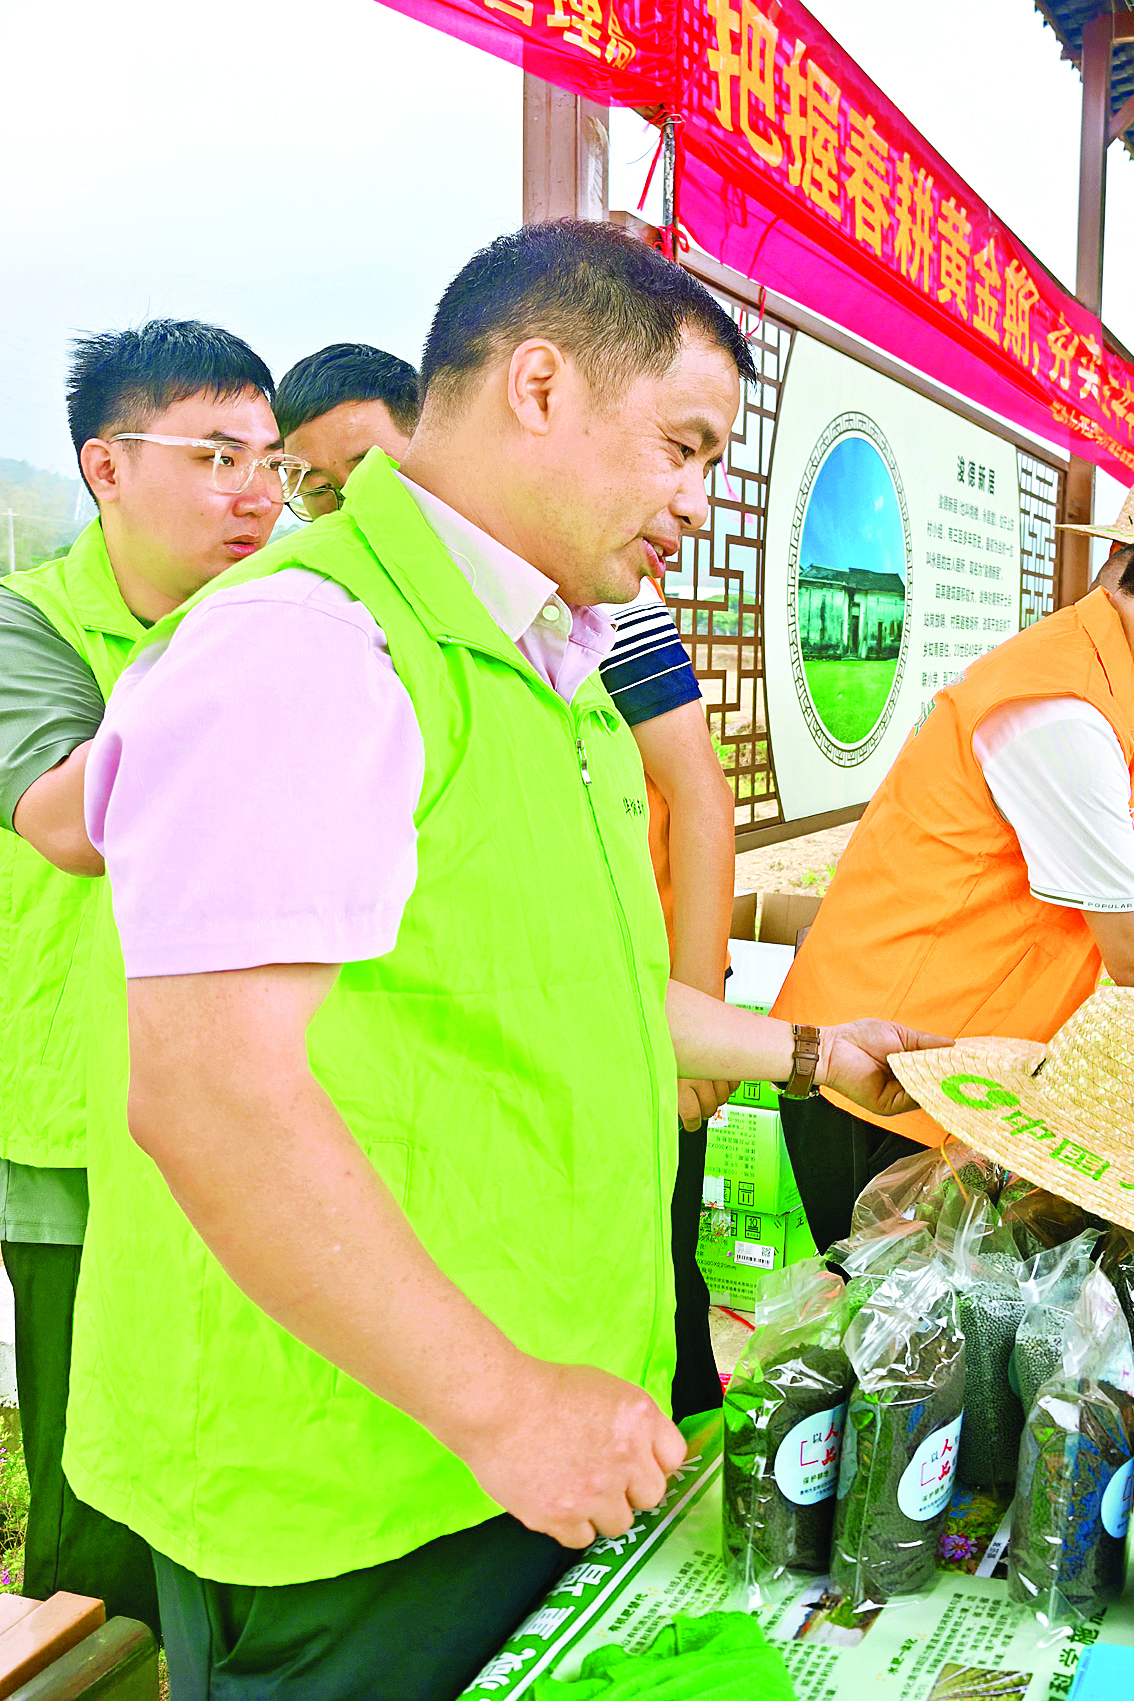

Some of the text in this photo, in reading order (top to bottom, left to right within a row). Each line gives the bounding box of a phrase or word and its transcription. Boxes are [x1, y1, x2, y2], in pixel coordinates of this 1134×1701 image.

[1087, 901, 1133, 909] POPULAR
[608, 1592, 649, 1632] 有机肥替代
